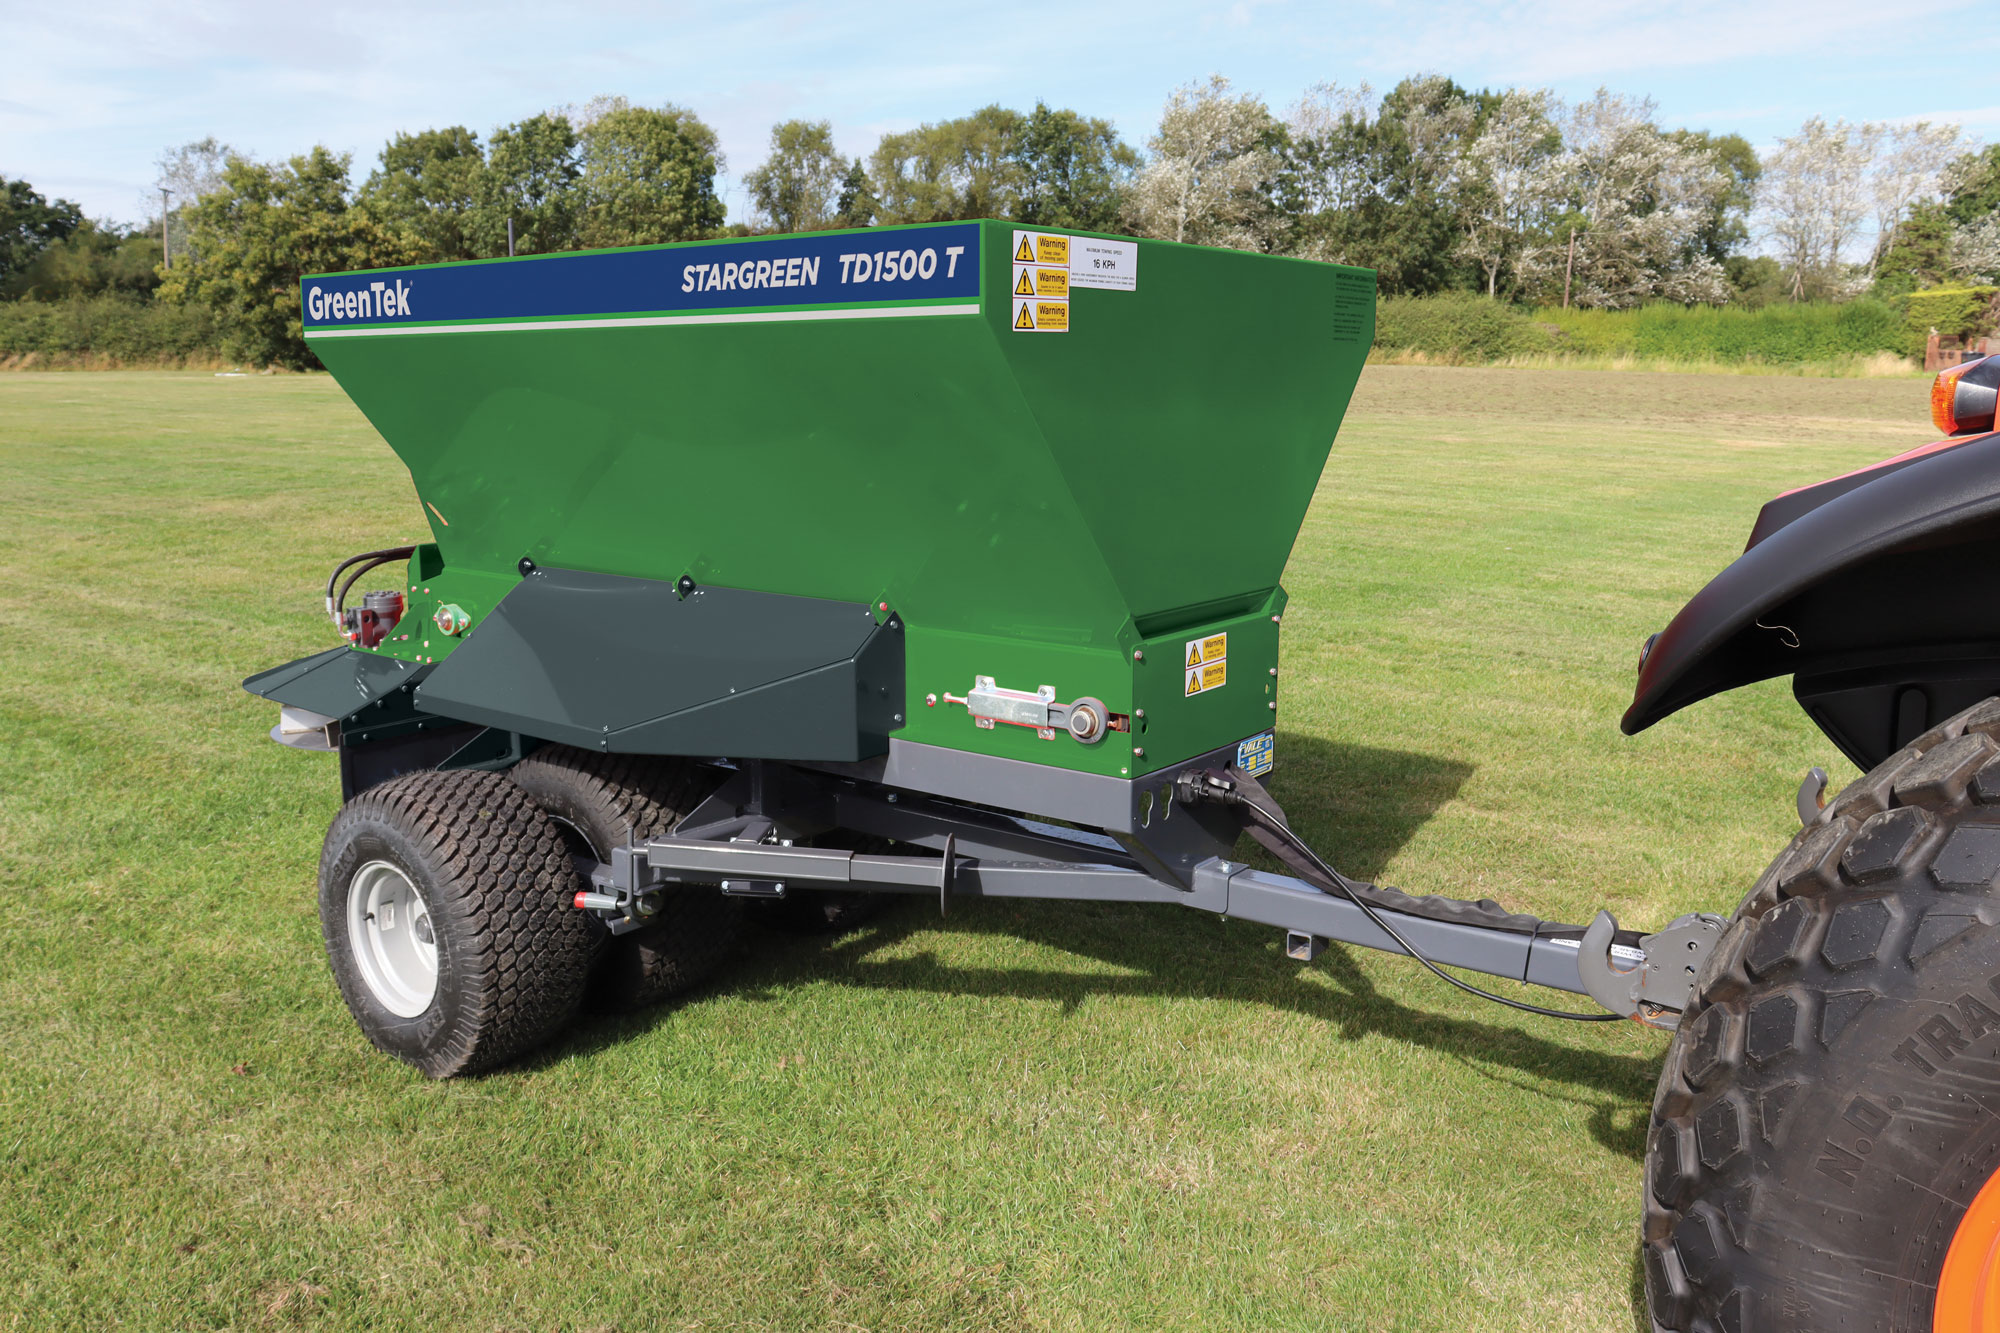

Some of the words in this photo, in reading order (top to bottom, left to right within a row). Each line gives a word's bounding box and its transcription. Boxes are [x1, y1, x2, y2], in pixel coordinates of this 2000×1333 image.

[1039, 238, 1066, 251] Warning
[681, 256, 820, 293] STARGREEN
[839, 248, 937, 284] TD1500
[945, 246, 965, 278] T
[1093, 259, 1101, 269] 16
[1102, 260, 1116, 270] KPH
[1039, 272, 1065, 285] Warning
[308, 279, 412, 321] GreenTek
[1039, 305, 1065, 317] Warning
[1204, 638, 1224, 649] Warning
[1204, 666, 1224, 677] Warning
